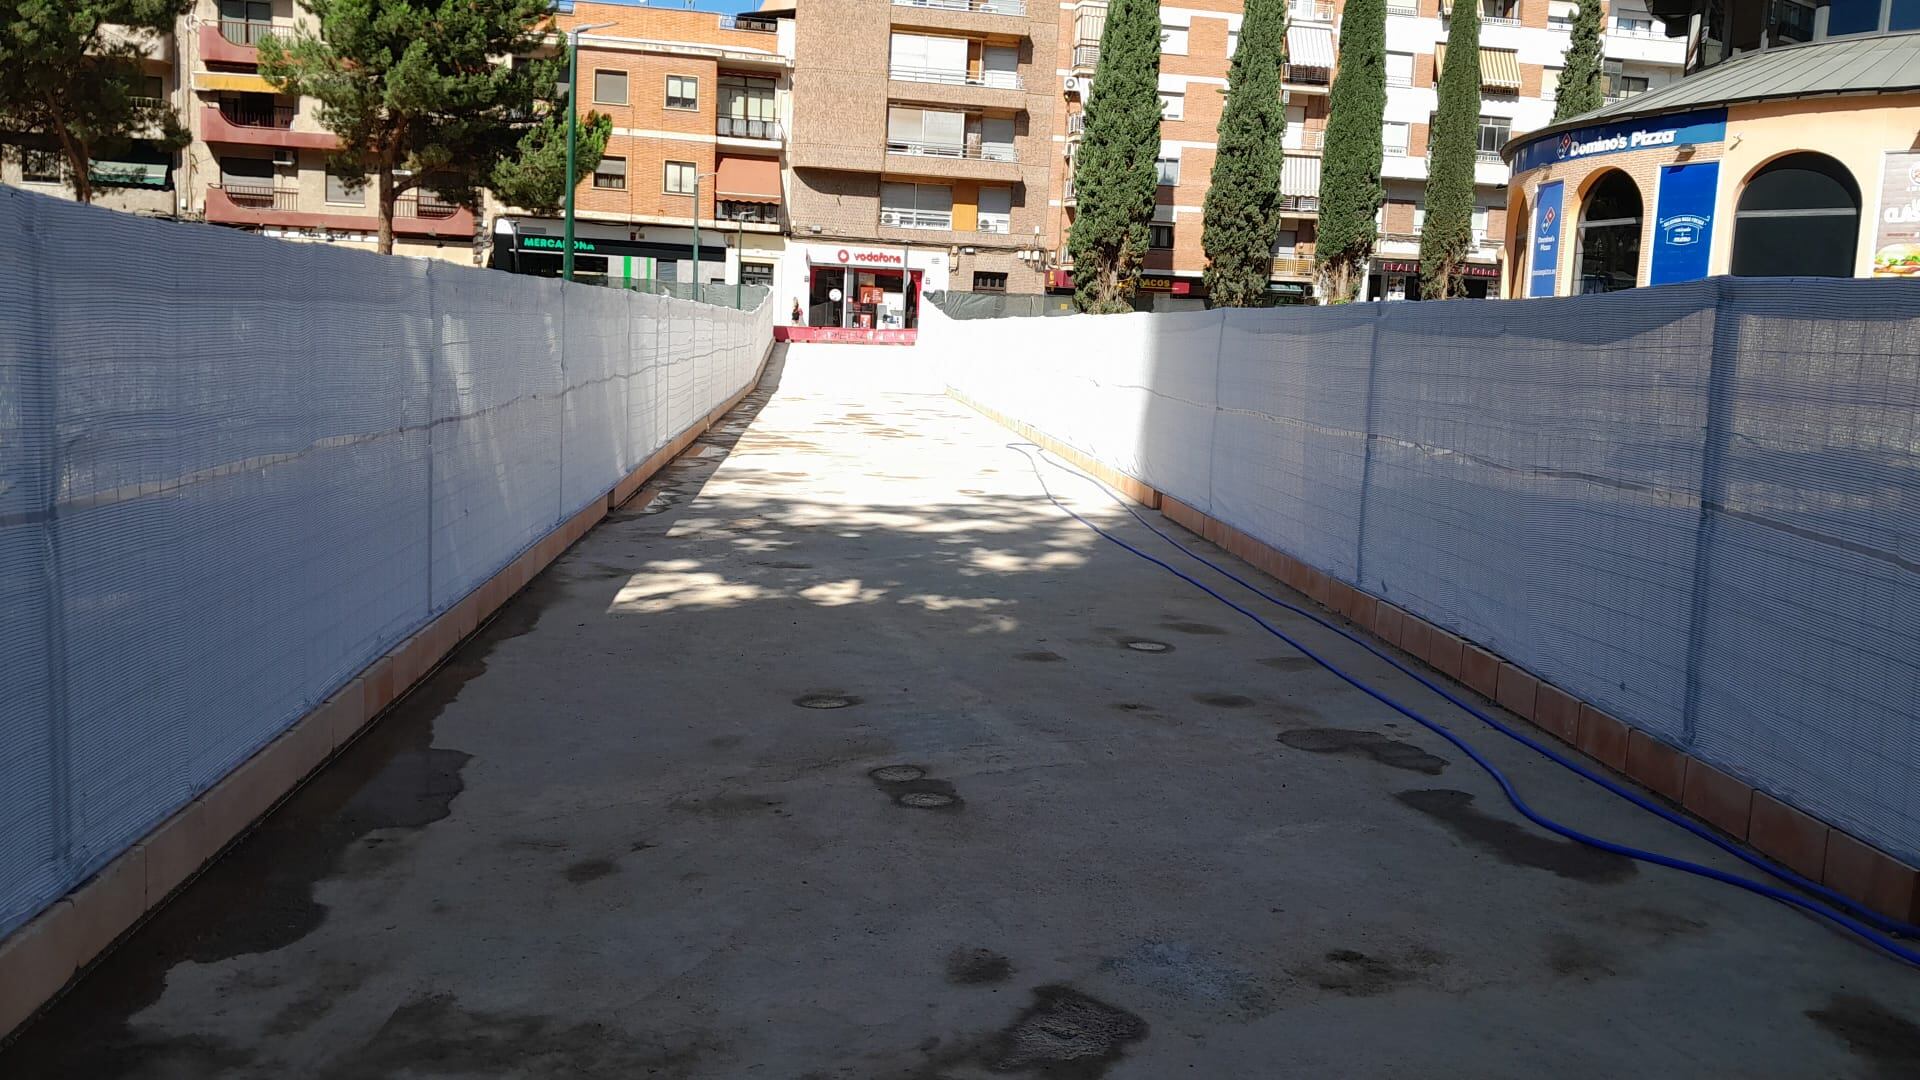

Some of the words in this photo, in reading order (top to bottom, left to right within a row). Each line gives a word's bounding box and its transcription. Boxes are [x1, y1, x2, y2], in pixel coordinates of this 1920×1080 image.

[1570, 133, 1627, 156] Domino's
[1631, 129, 1677, 147] Pizza
[524, 238, 595, 250] MERCAONA
[853, 252, 901, 264] vodafone
